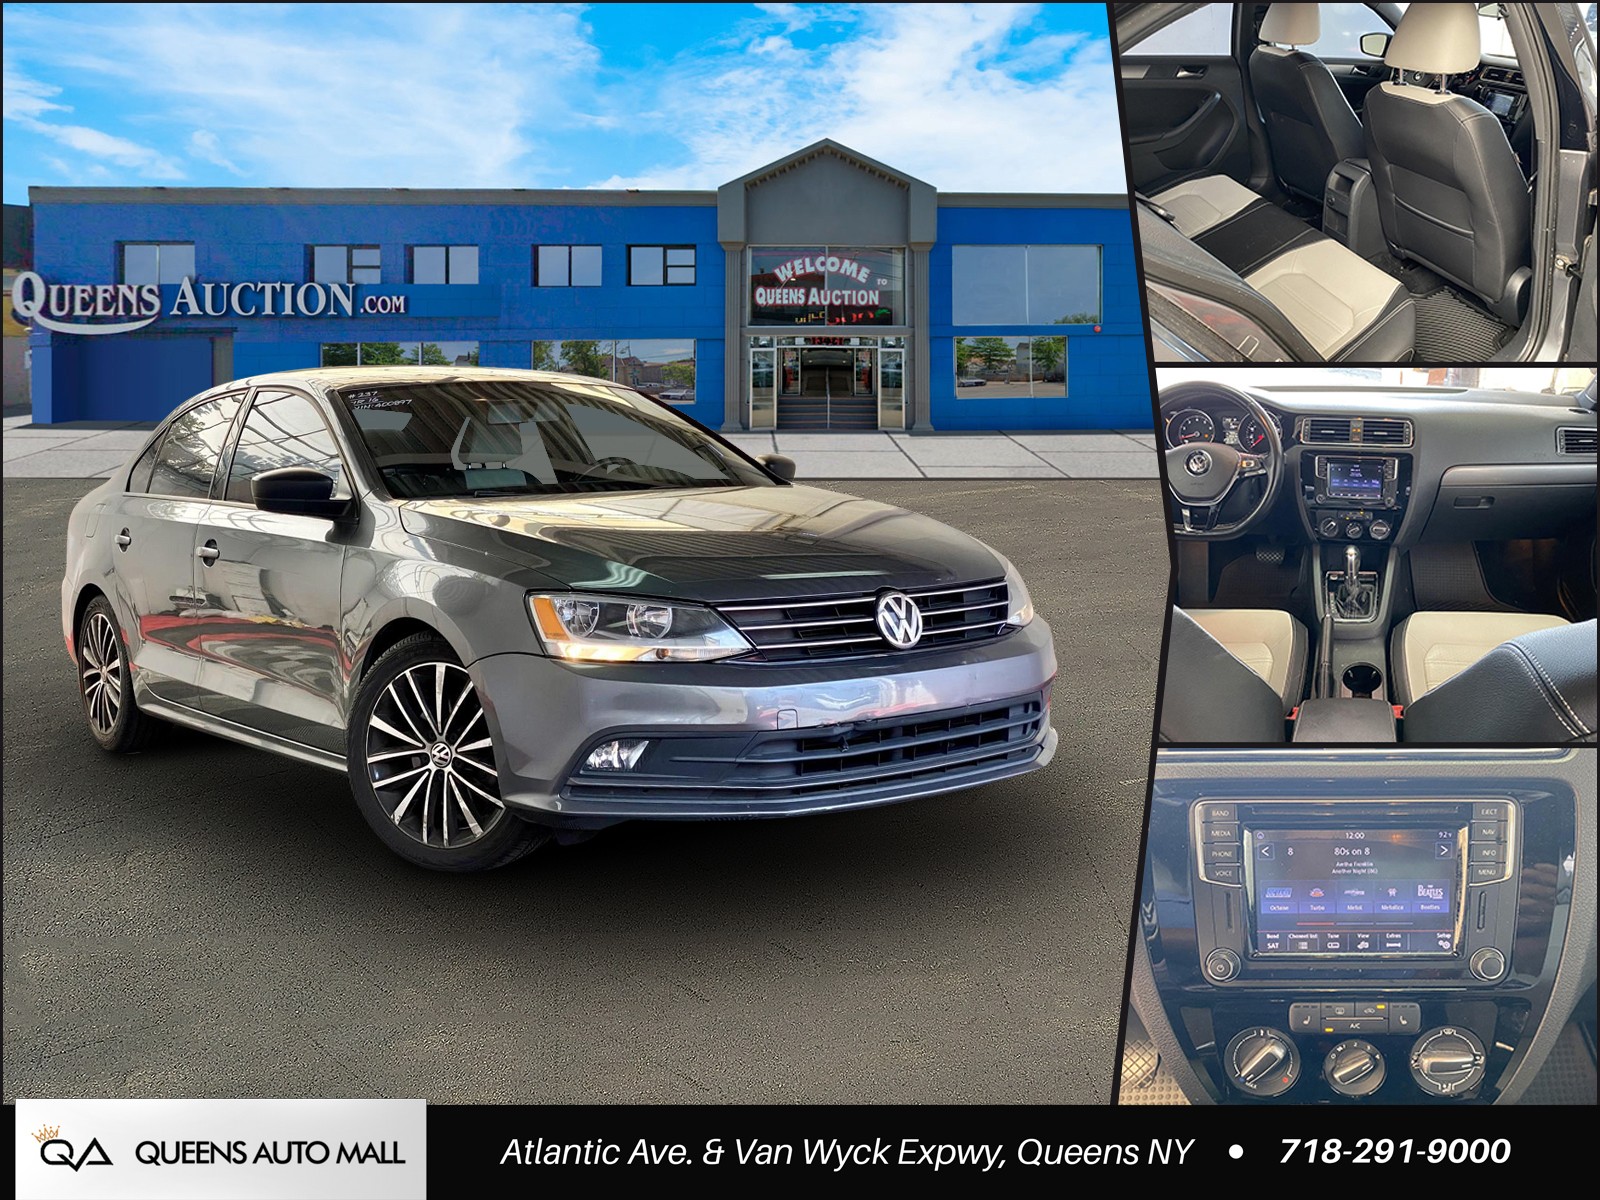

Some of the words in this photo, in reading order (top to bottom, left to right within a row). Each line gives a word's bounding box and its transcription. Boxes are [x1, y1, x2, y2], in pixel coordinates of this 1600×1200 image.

[773, 255, 871, 285] WELCOME
[754, 286, 806, 306] QUEENS
[807, 287, 880, 306] AUCTION
[11, 270, 162, 335] QUEENS
[1211, 809, 1230, 818] BAND
[1210, 829, 1232, 837] MEDIA
[1345, 831, 1366, 840] 12:00
[1482, 828, 1496, 836] NAV
[1211, 850, 1233, 858] PHONE
[1287, 846, 1294, 857] 8
[1333, 846, 1350, 856] 80s
[1351, 848, 1362, 856] on
[1364, 846, 1371, 856] 8
[1215, 869, 1233, 877] VOICE
[1478, 868, 1497, 876] MENU
[1266, 941, 1280, 950] SAT
